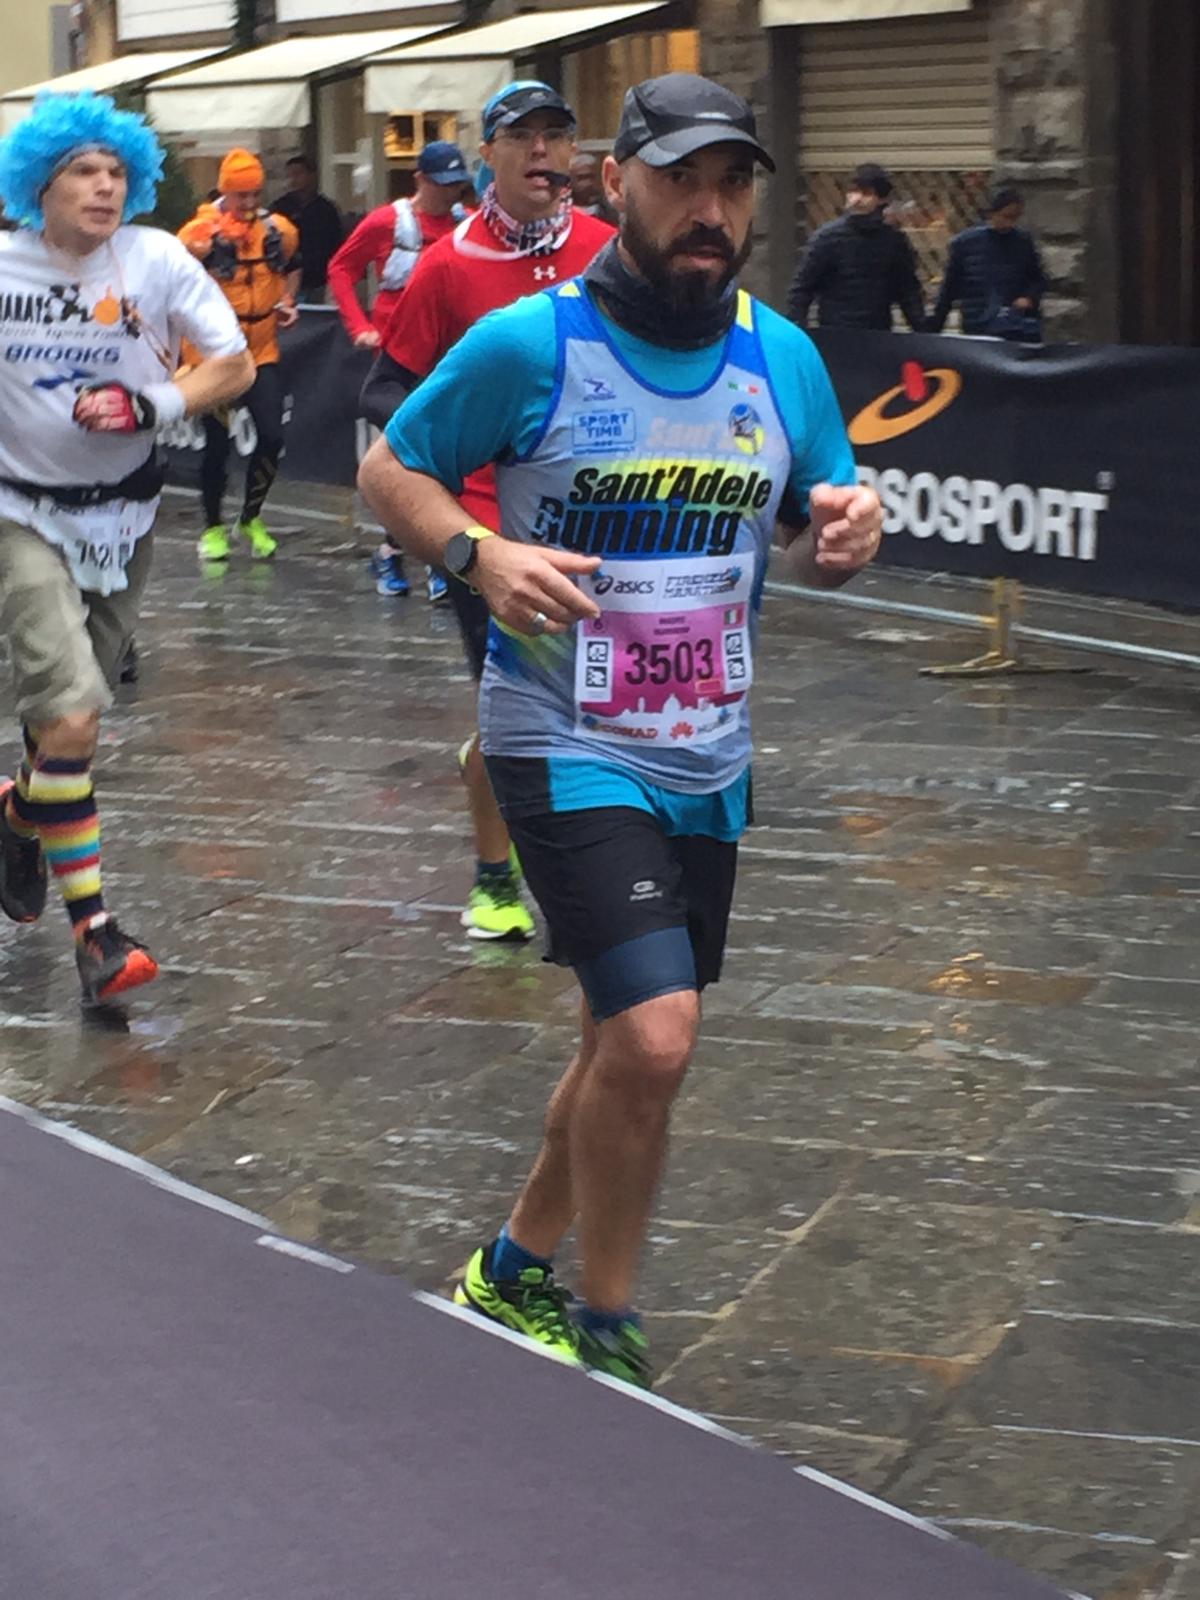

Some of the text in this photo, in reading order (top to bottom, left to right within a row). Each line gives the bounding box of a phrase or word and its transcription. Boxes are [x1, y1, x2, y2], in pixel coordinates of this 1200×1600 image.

[5, 346, 120, 362] BROOKS
[579, 412, 628, 427] SPORT
[586, 425, 622, 438] TIME
[568, 466, 773, 509] Sant'Adele
[531, 496, 743, 557] Running
[613, 579, 655, 594] asics
[625, 639, 714, 685] 3503
